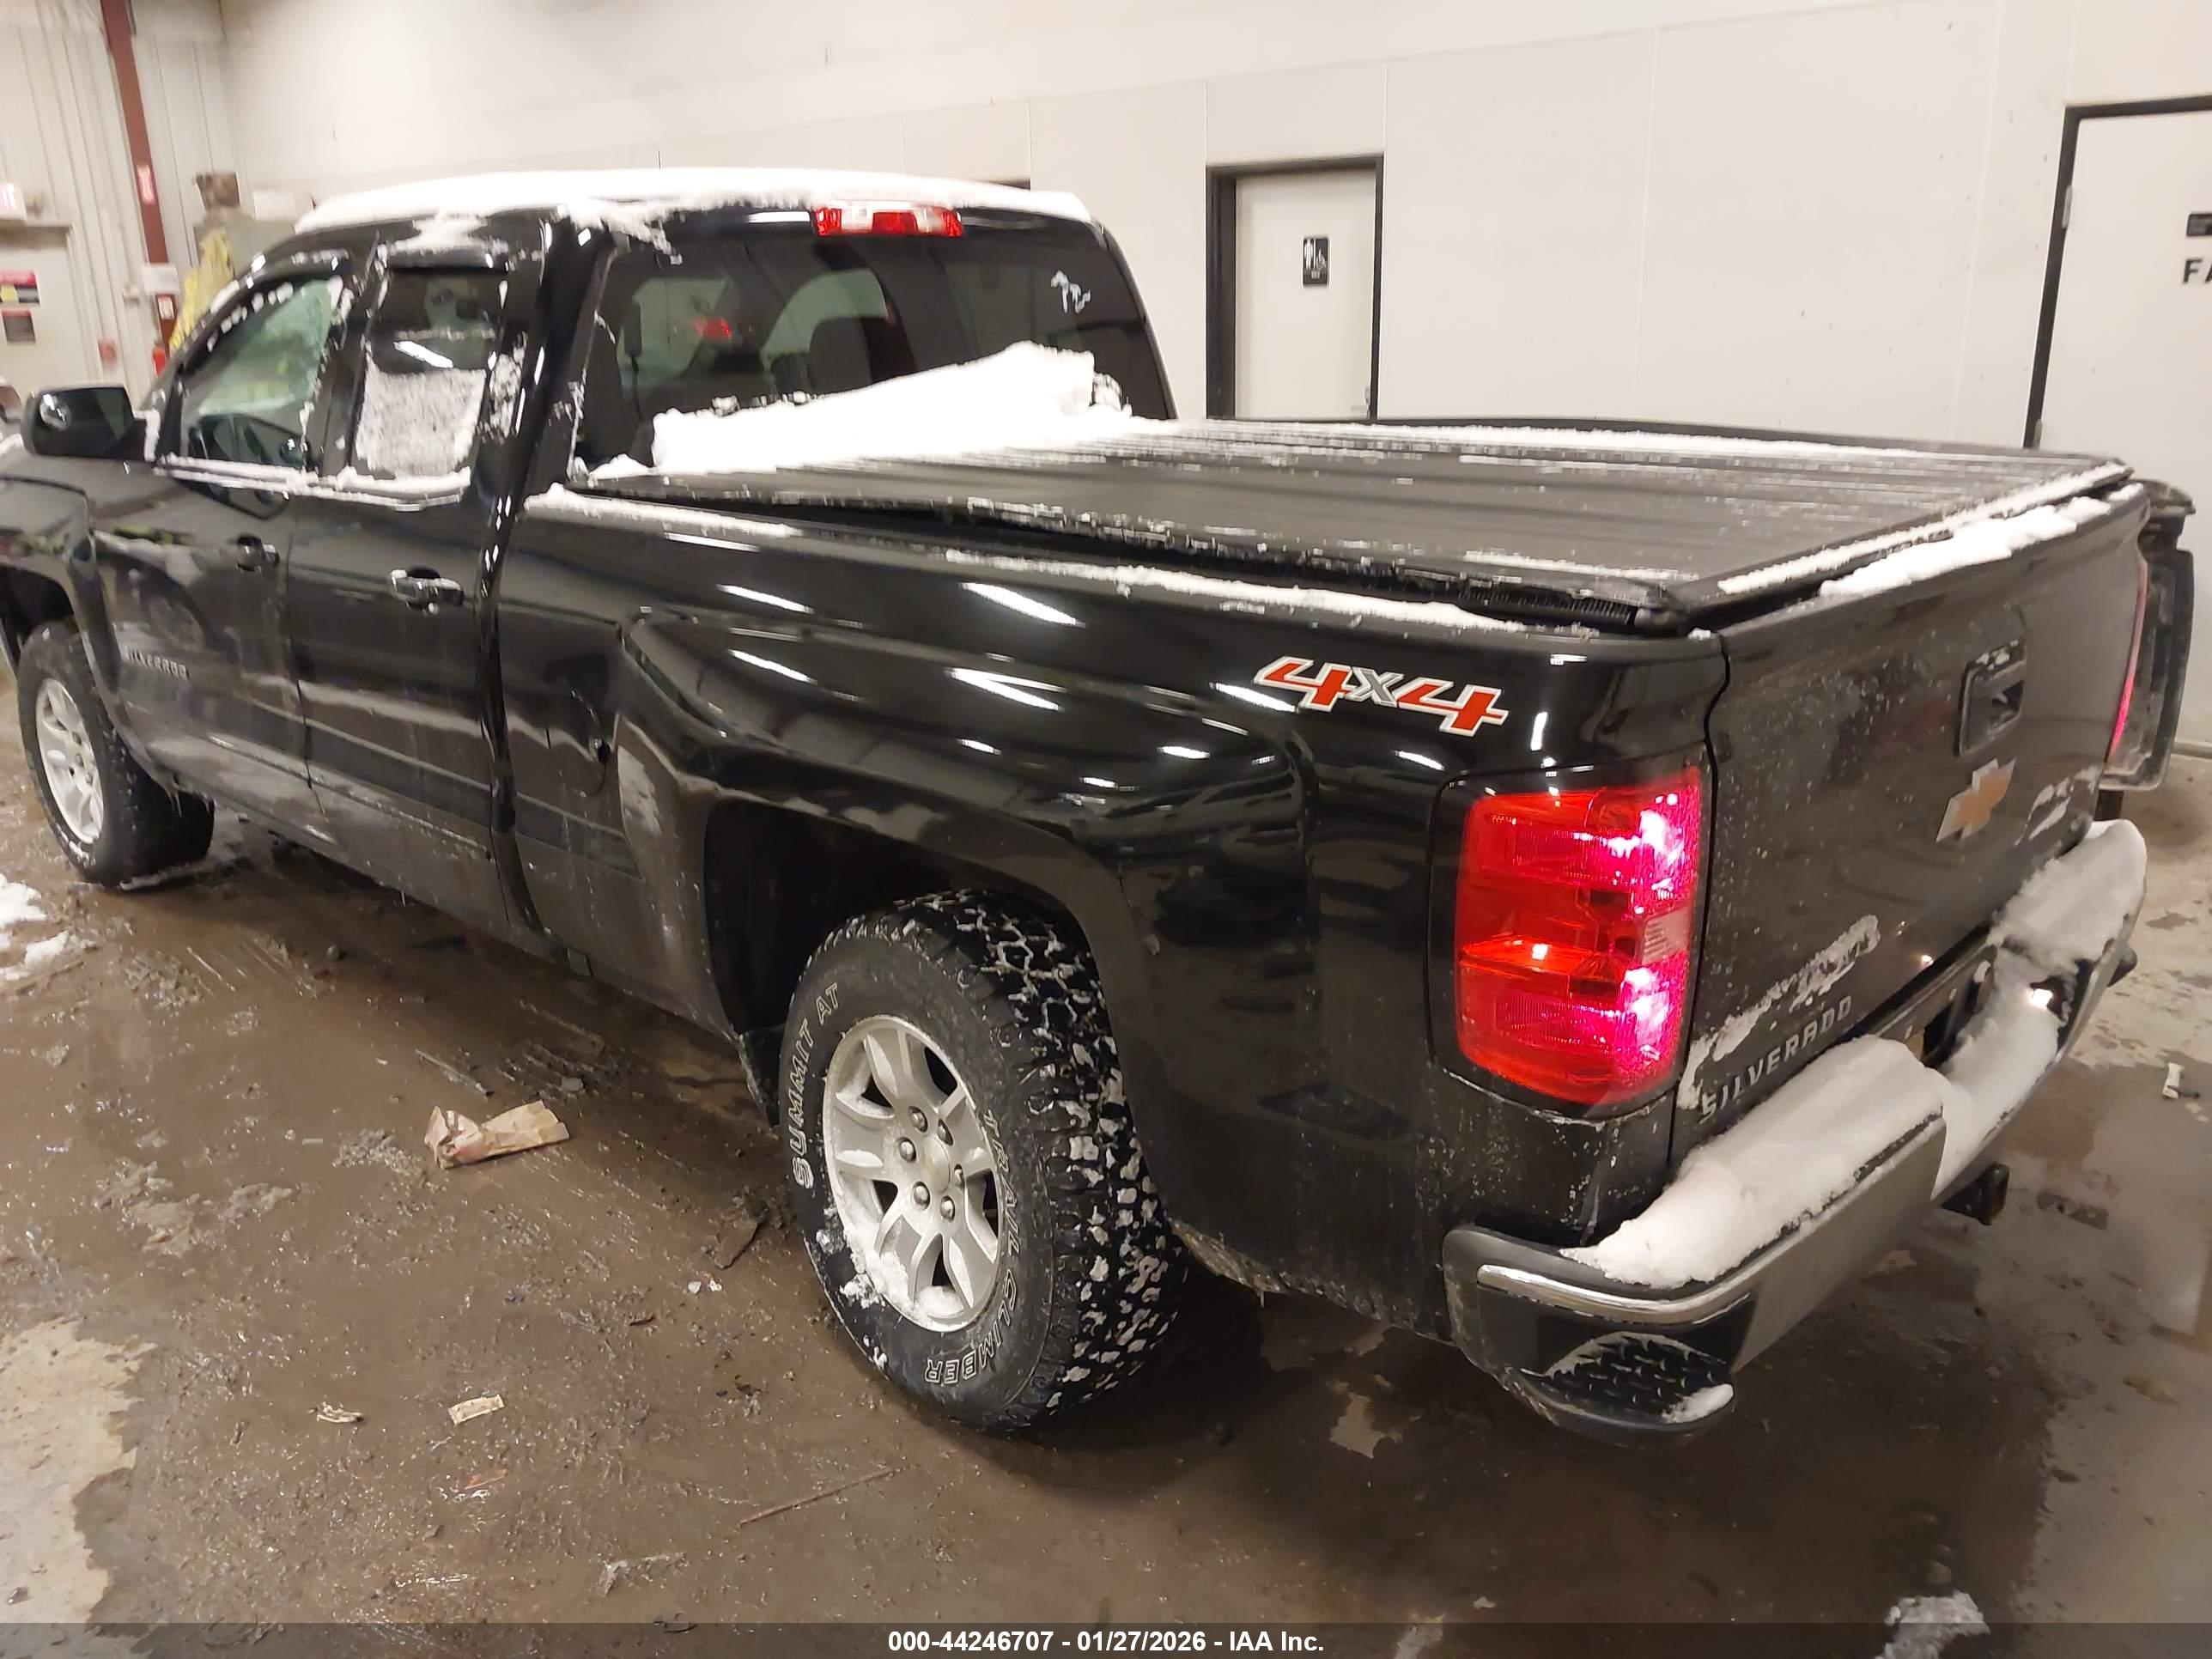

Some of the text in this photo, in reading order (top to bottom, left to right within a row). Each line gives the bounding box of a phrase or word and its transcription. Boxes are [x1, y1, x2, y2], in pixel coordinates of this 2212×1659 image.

[788, 982, 838, 1190] SUMMIT AT
[1699, 995, 1852, 1124] SILVERADO
[925, 1109, 1020, 1384] TRAIL CLIMBER
